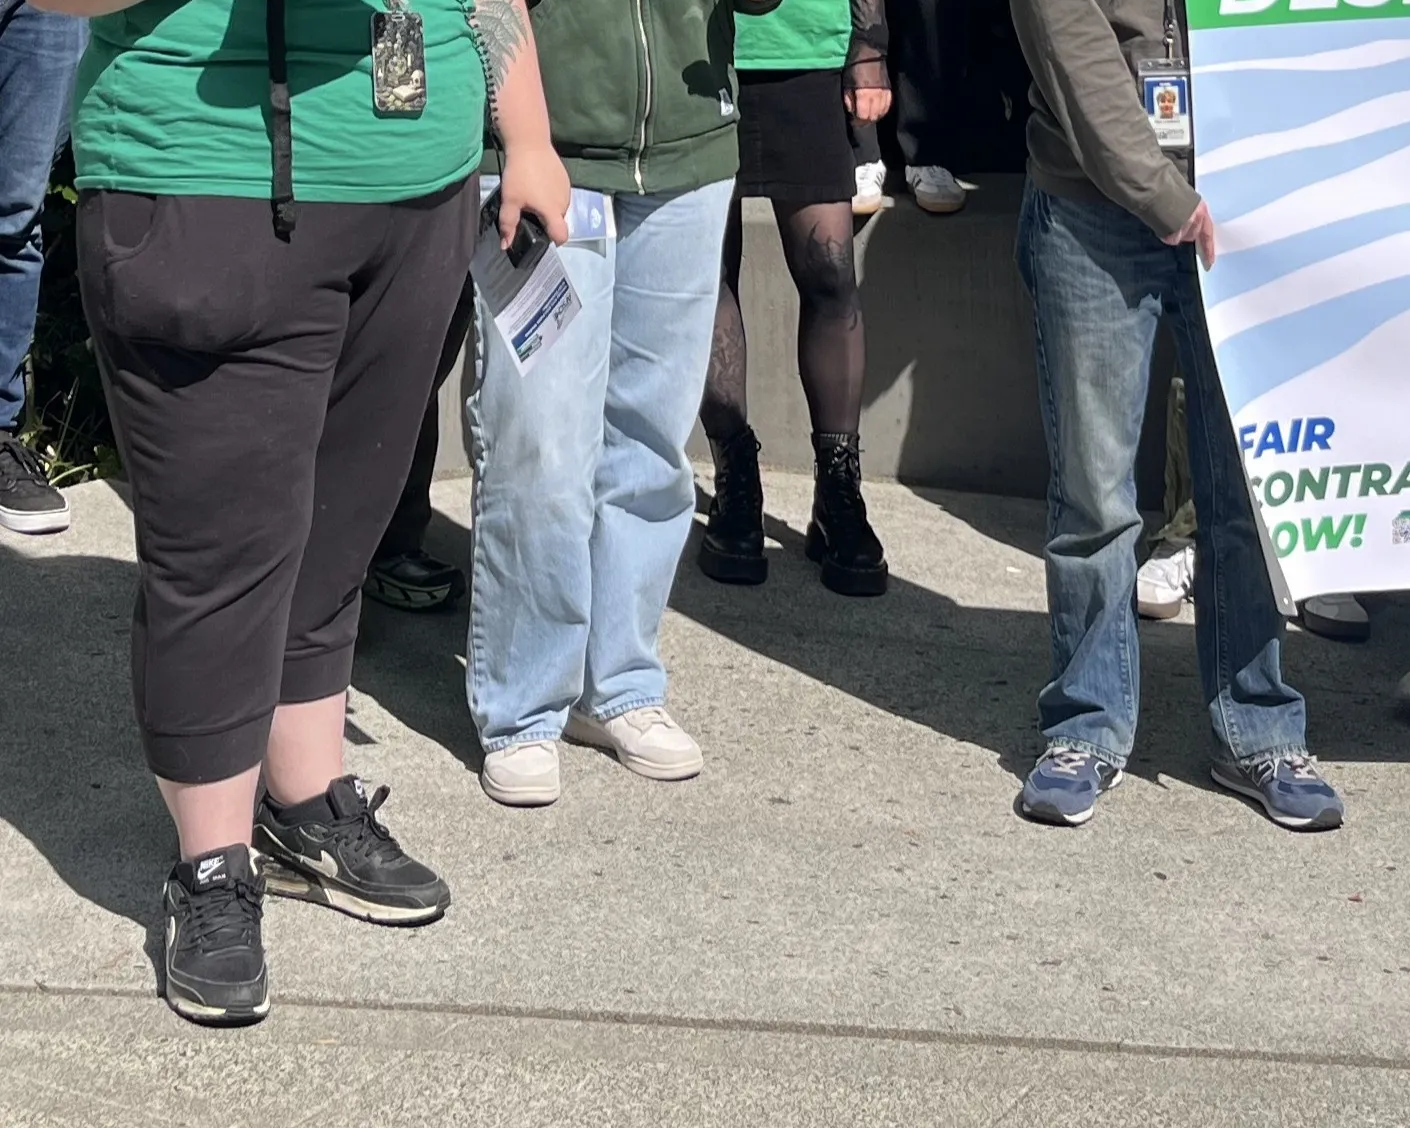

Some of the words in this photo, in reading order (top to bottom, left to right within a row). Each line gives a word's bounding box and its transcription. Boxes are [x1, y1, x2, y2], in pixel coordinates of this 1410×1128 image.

[1239, 416, 1336, 459] FAIR
[1270, 513, 1368, 559] OW!
[200, 856, 222, 871] NIKE
